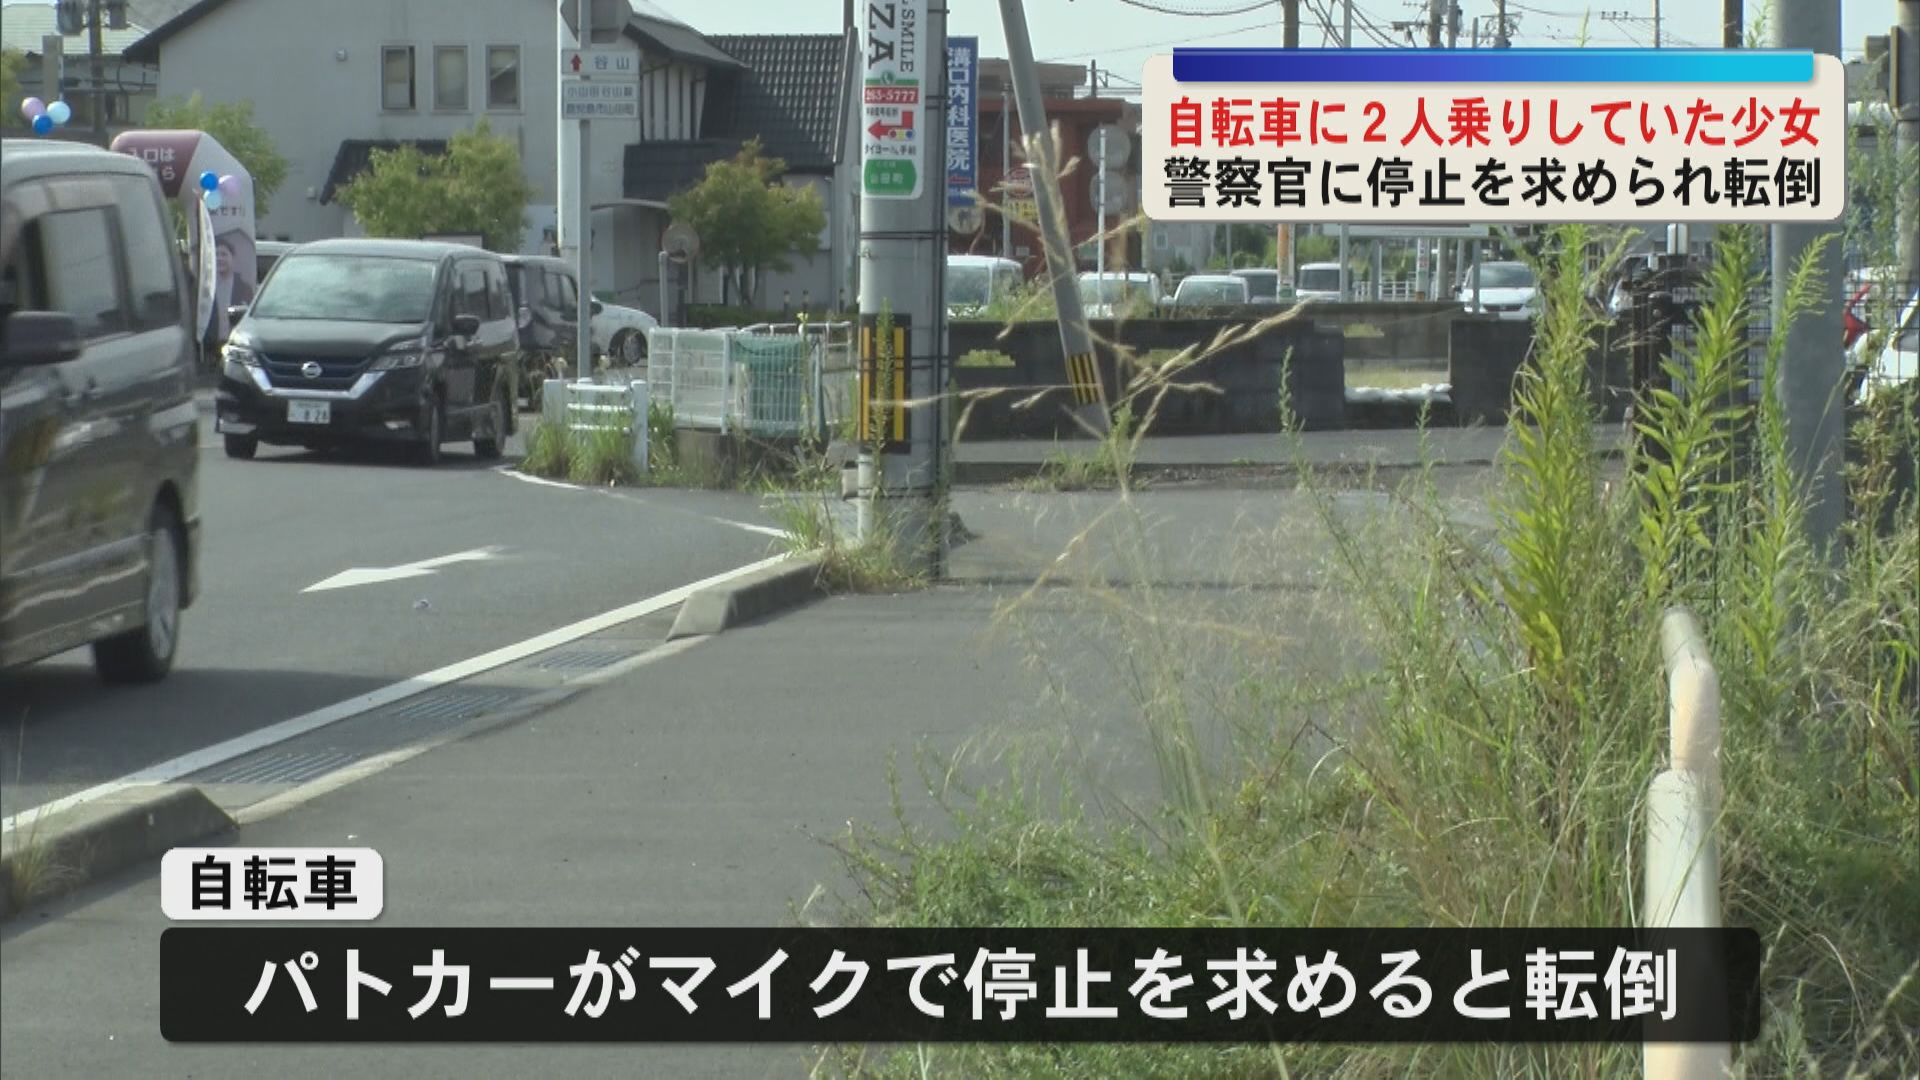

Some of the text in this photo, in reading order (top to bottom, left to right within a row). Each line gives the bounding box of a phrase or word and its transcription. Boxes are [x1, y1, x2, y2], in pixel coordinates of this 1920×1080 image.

[594, 55, 630, 70] 谷山
[901, 9, 915, 72] SMILE
[947, 47, 971, 171] 溝口内科医院
